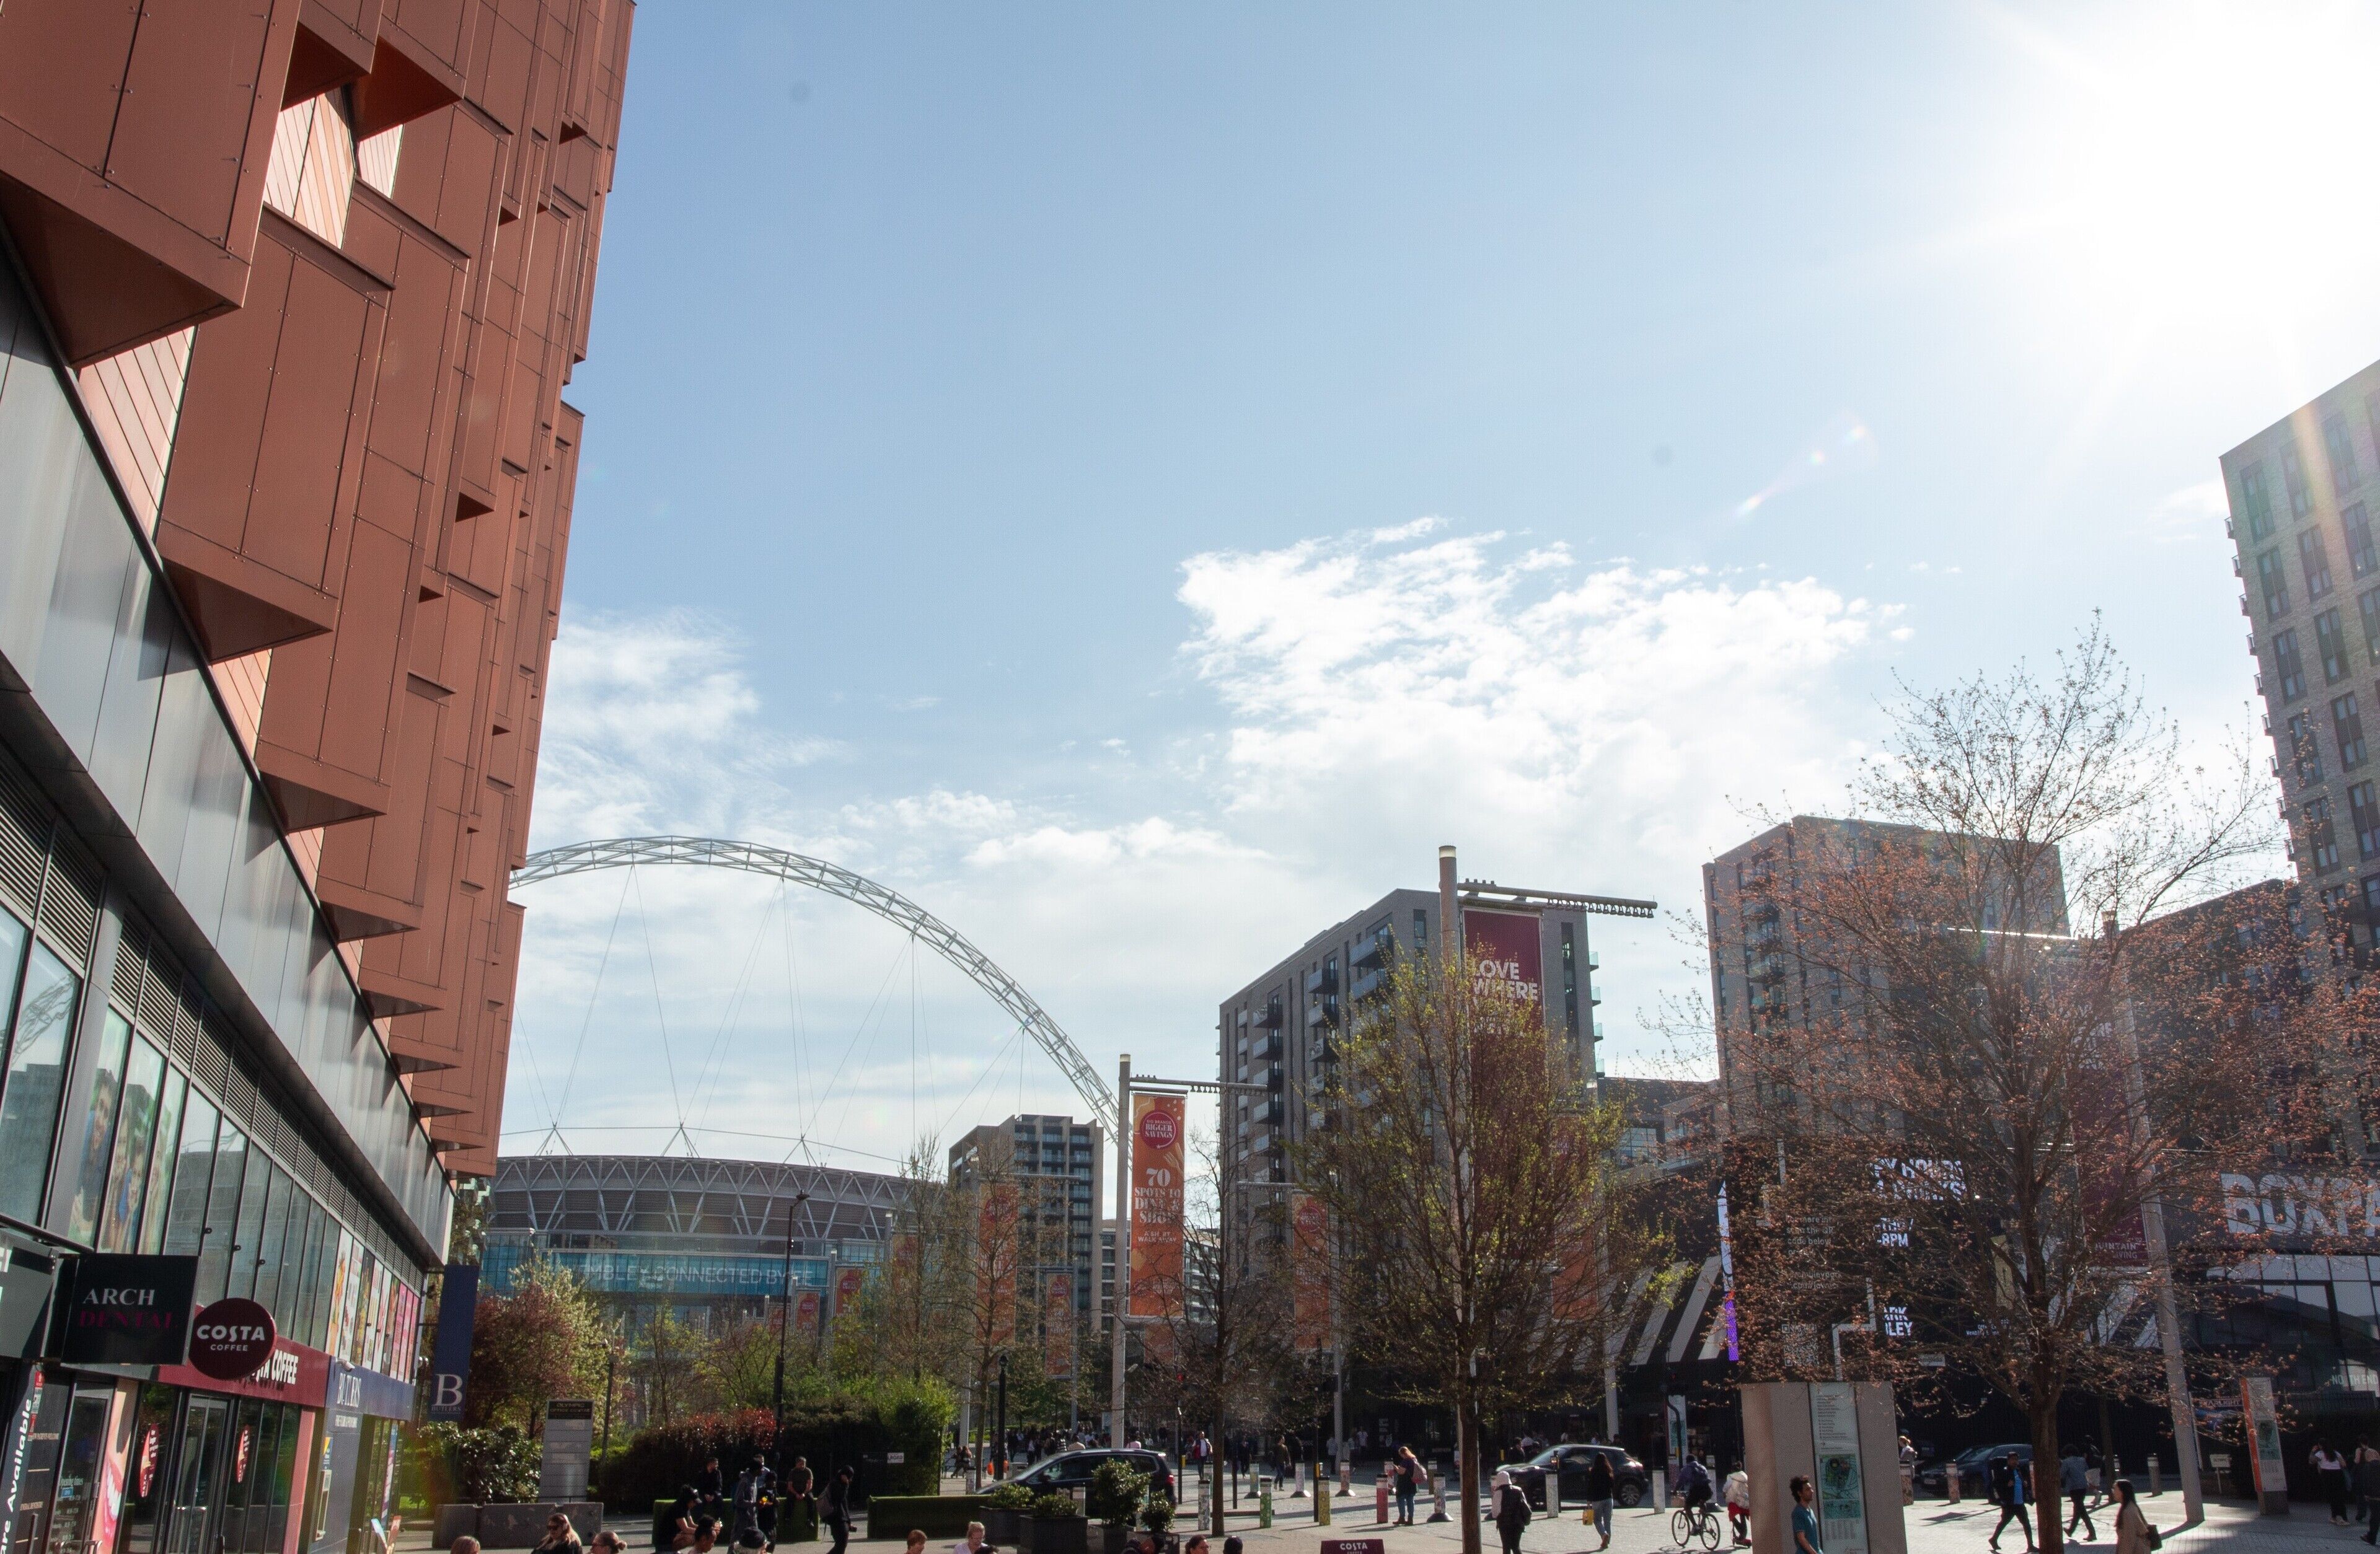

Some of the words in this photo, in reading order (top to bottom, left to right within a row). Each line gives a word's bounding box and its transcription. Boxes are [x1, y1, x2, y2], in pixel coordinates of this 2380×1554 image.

[1473, 978, 1538, 1002] WHERE
[1145, 1123, 1173, 1132] BIGGER
[1147, 1168, 1171, 1187] 70
[1135, 1187, 1166, 1198] SPOTS
[1170, 1189, 1181, 1198] TO
[655, 1266, 762, 1285] CONNECTED
[766, 1270, 787, 1285] BY
[83, 1288, 156, 1306] ARCH
[79, 1309, 179, 1330] DENTAL
[196, 1324, 265, 1342] COSTA
[210, 1344, 249, 1352] COFFEE
[271, 1348, 299, 1385] COFFEE
[434, 1374, 463, 1406] B
[7, 1398, 32, 1512] Available
[1339, 1542, 1368, 1550] COSTA
